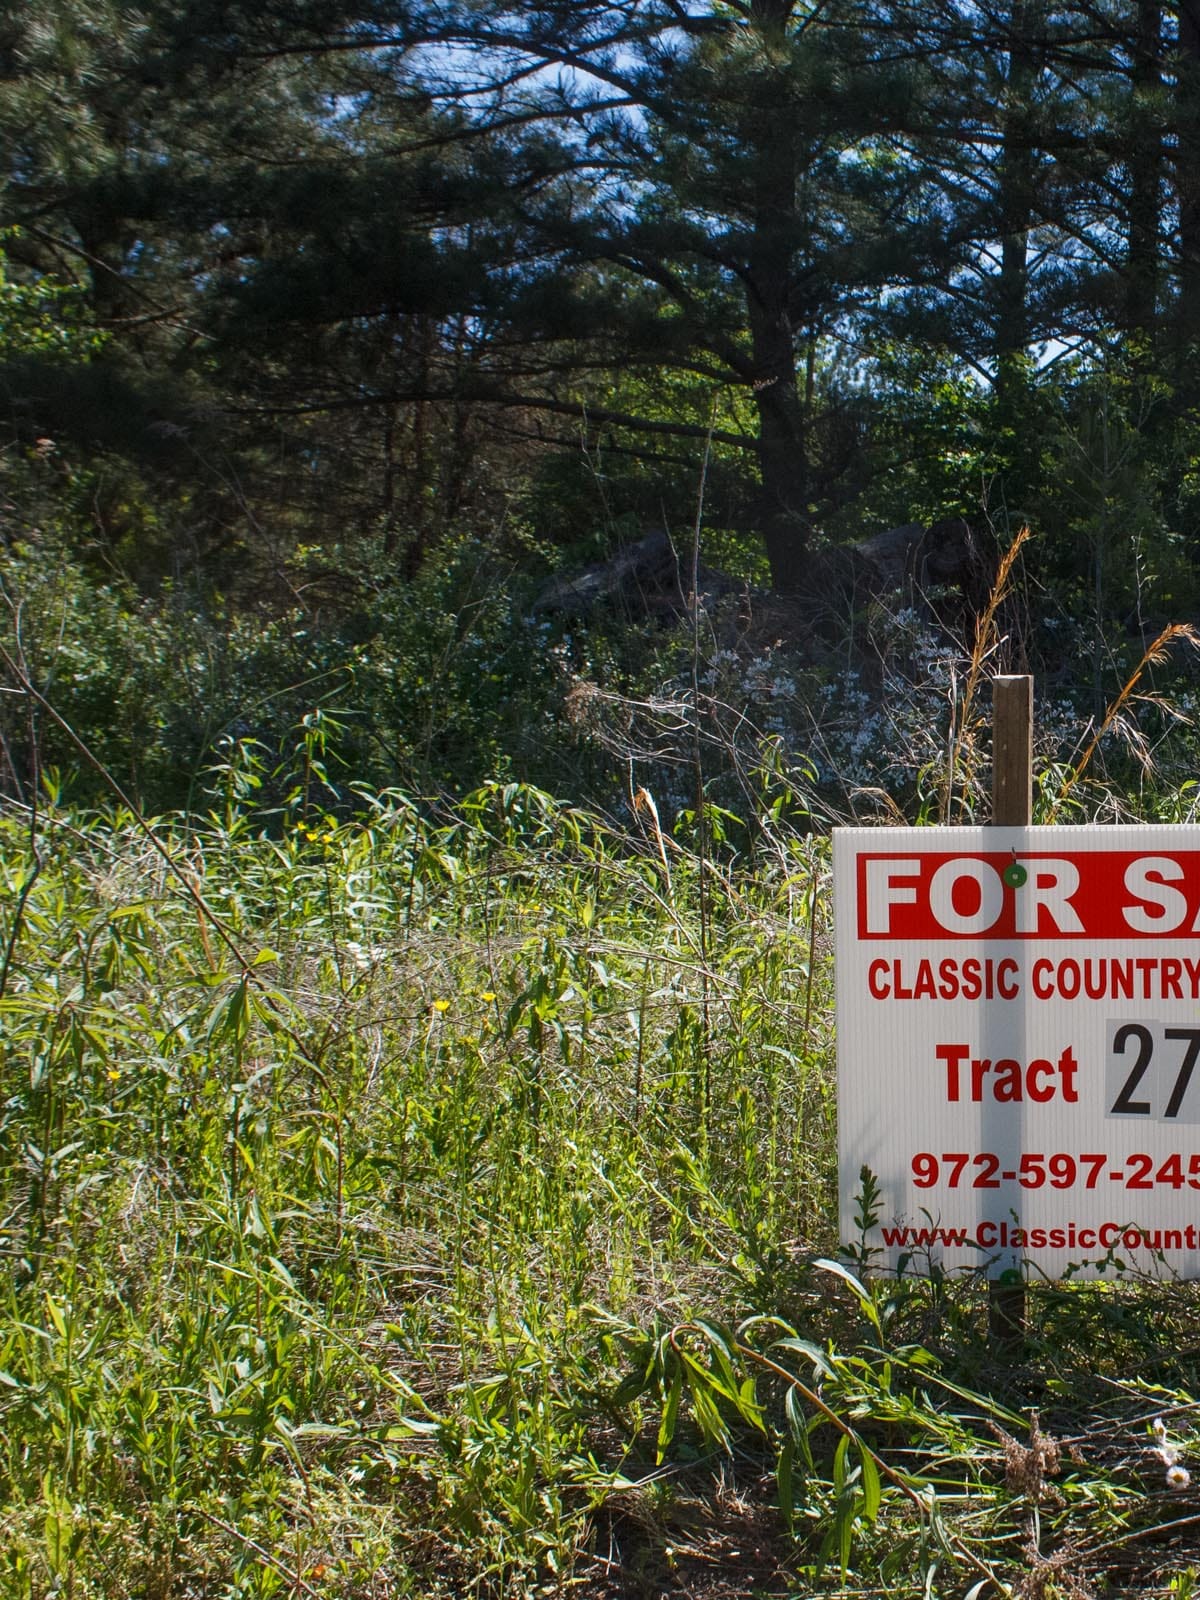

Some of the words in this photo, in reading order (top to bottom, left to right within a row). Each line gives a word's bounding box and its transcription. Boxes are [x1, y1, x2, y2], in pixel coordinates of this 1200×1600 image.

[865, 857, 1086, 934] FOR
[868, 958, 1020, 1001] CLASSIC
[936, 1044, 1079, 1103] Tract
